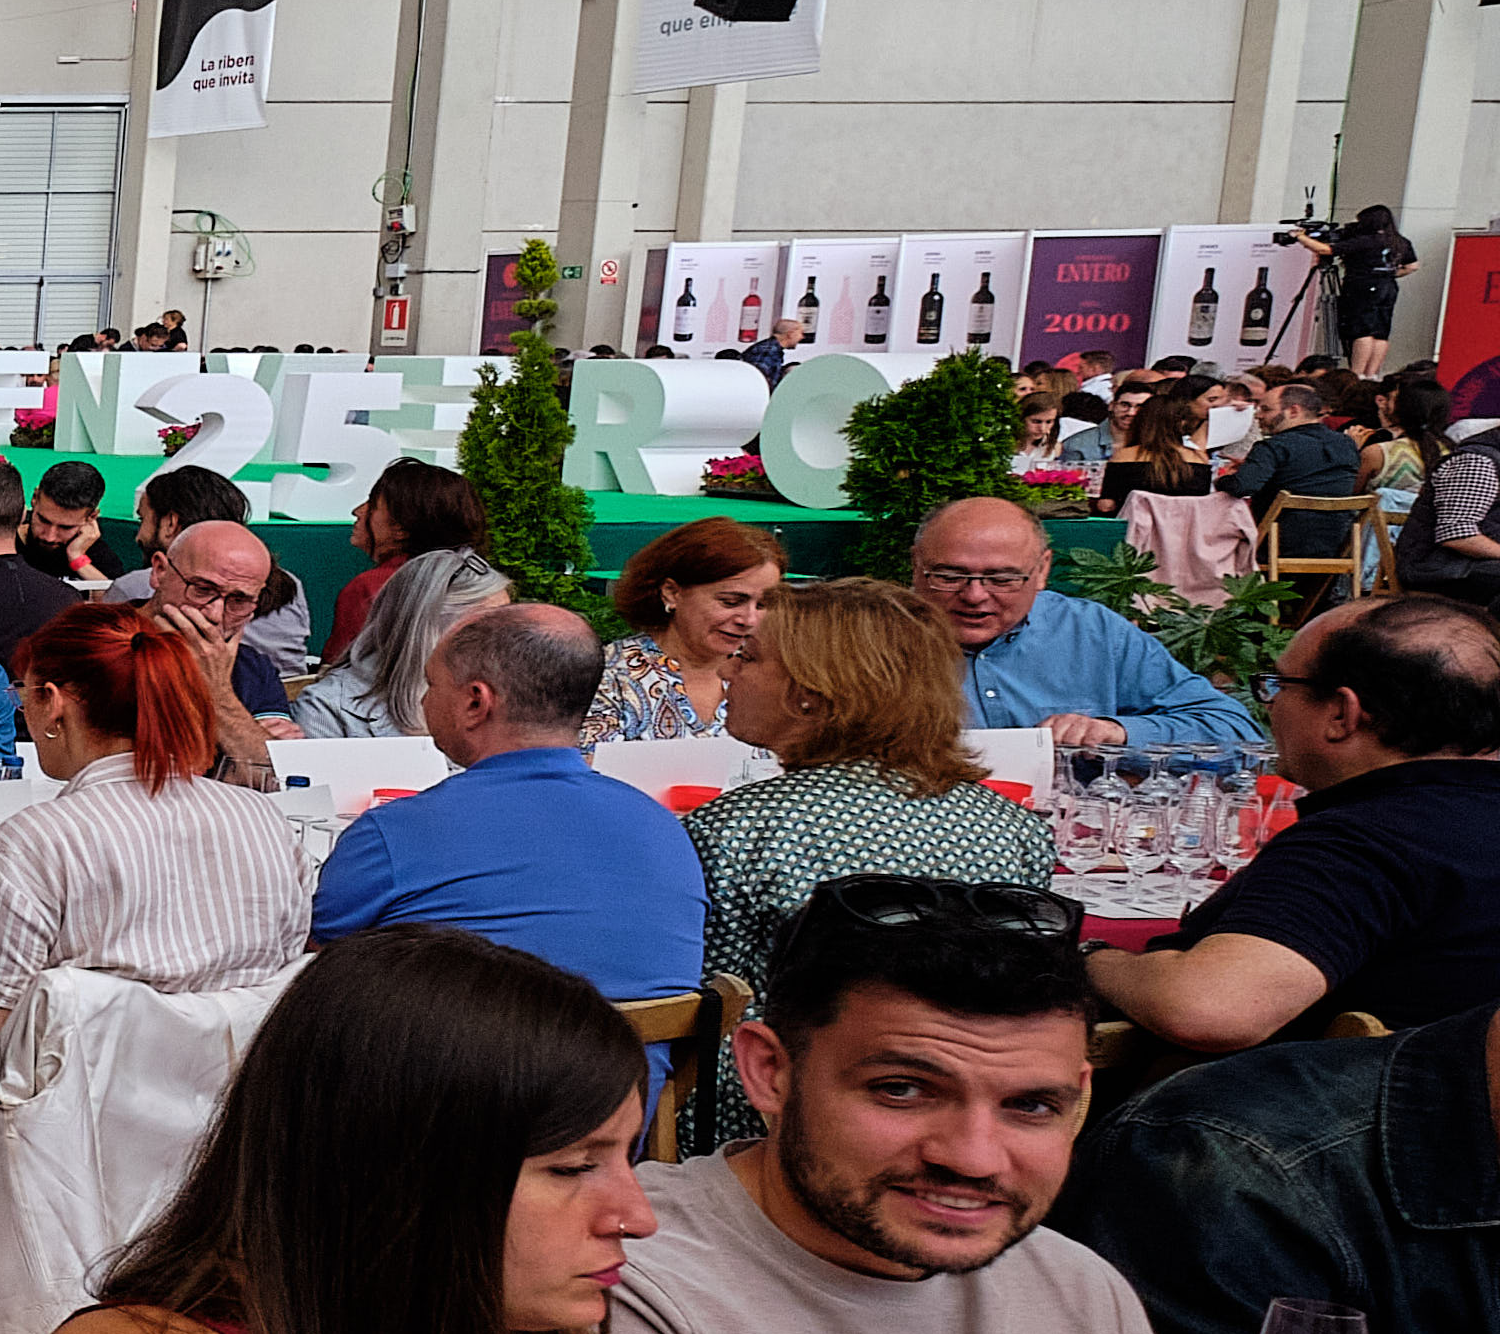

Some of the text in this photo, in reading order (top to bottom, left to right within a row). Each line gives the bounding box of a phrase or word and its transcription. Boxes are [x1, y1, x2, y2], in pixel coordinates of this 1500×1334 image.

[660, 17, 695, 37] que
[200, 52, 255, 73] La ribera
[192, 72, 256, 93] que invita
[1043, 313, 1132, 334] 2000
[134, 372, 402, 523] 25
